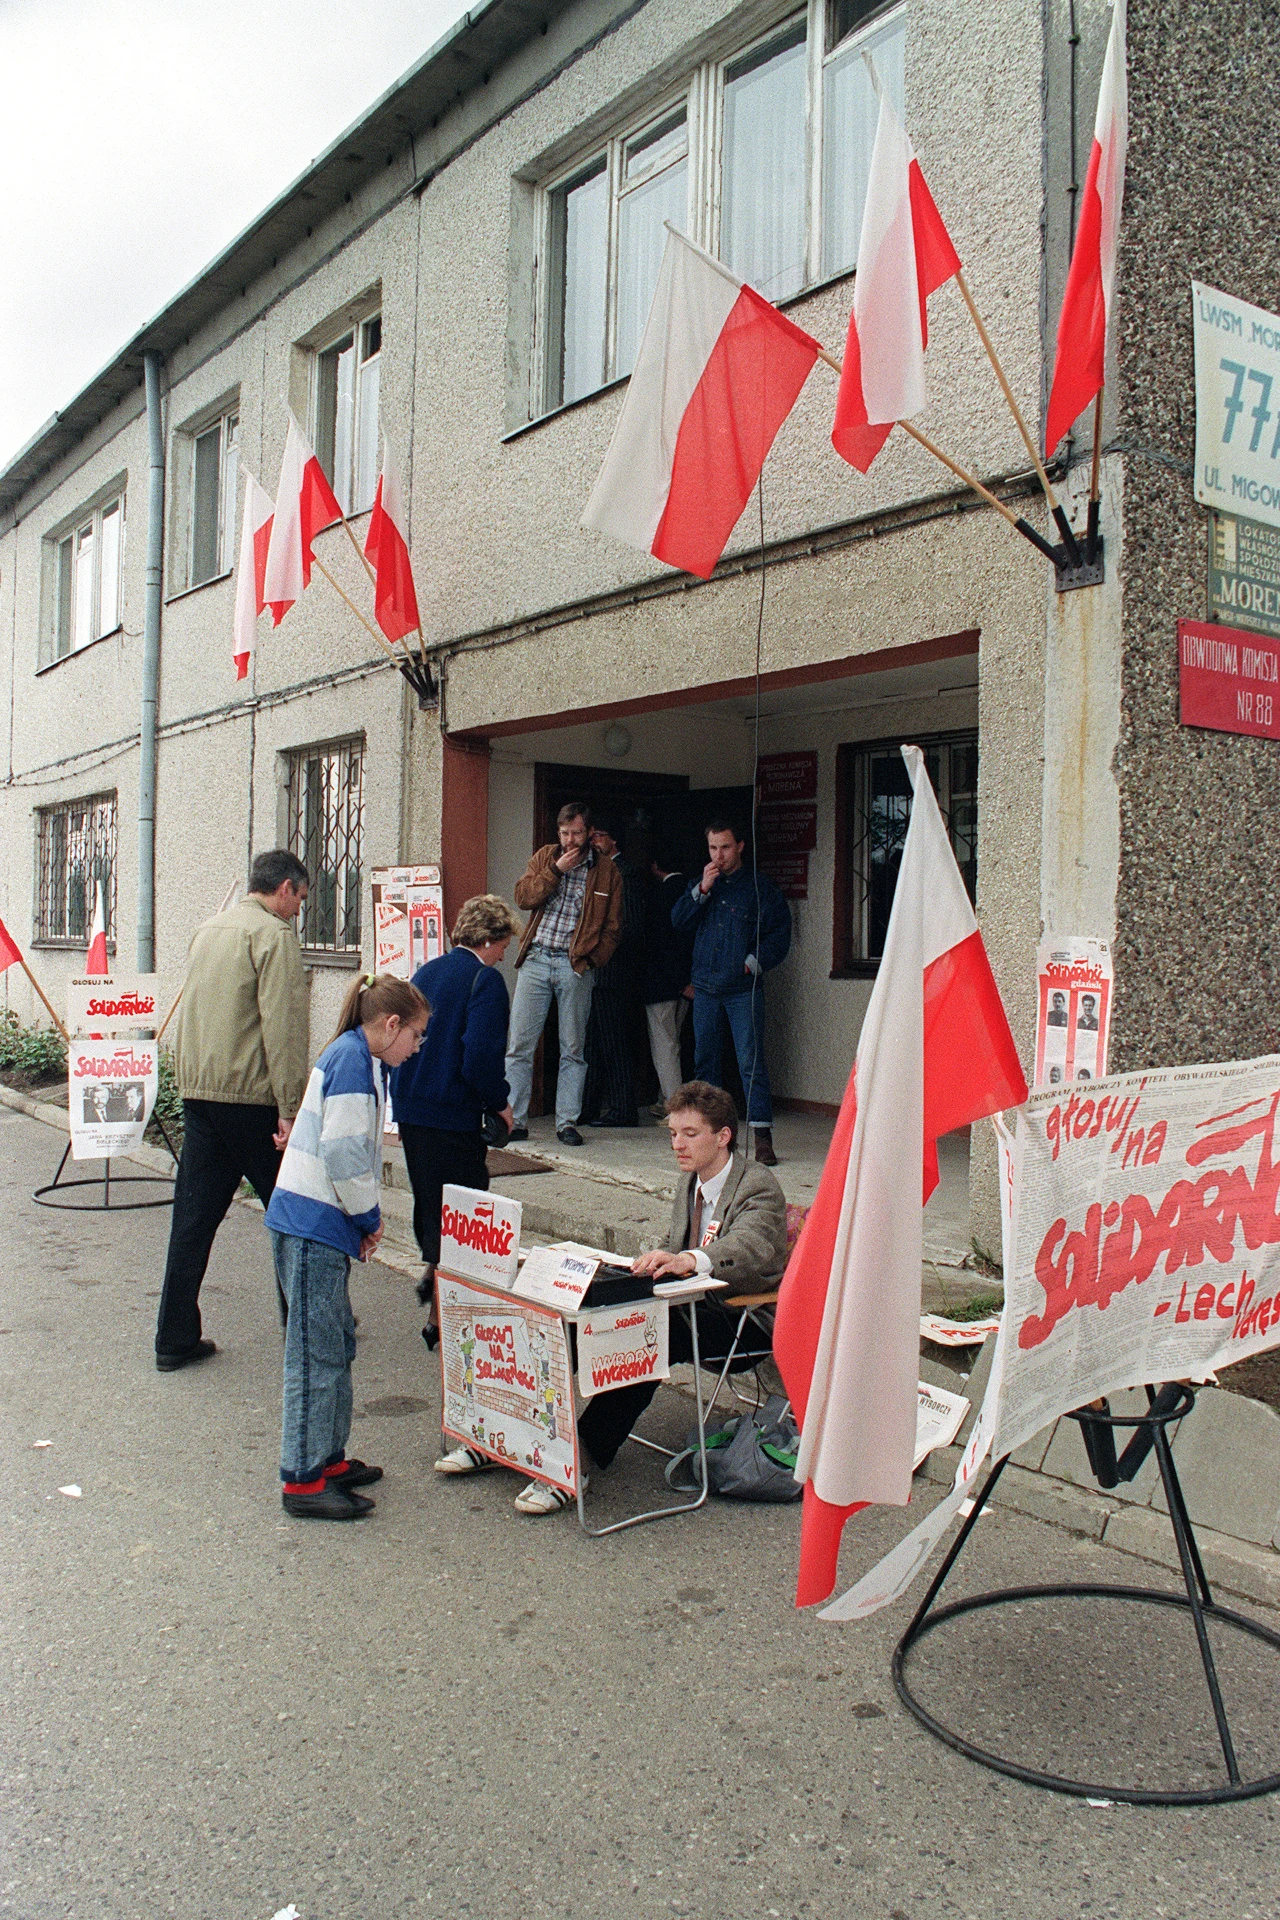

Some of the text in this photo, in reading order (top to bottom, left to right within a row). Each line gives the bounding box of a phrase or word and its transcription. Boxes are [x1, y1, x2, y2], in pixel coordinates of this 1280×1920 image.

[1200, 300, 1242, 337] LWSM
[1204, 465, 1226, 492] UL.
[1239, 524, 1280, 546] LOKATO
[1183, 635, 1279, 683] OBWODOWA KOMISJA
[1237, 690, 1273, 726] NR 88
[1075, 1080, 1122, 1094] WYBORCZY
[1172, 1067, 1249, 1082] OBYWATELSKIEGO
[1046, 1080, 1147, 1162] głosuj
[1121, 1120, 1168, 1170] na
[584, 1323, 593, 1336] 4
[489, 1344, 505, 1363] NA
[591, 1344, 659, 1372] WYBORY
[592, 1353, 659, 1388] WYGRAMY
[919, 1397, 952, 1416] WYBORCZY
